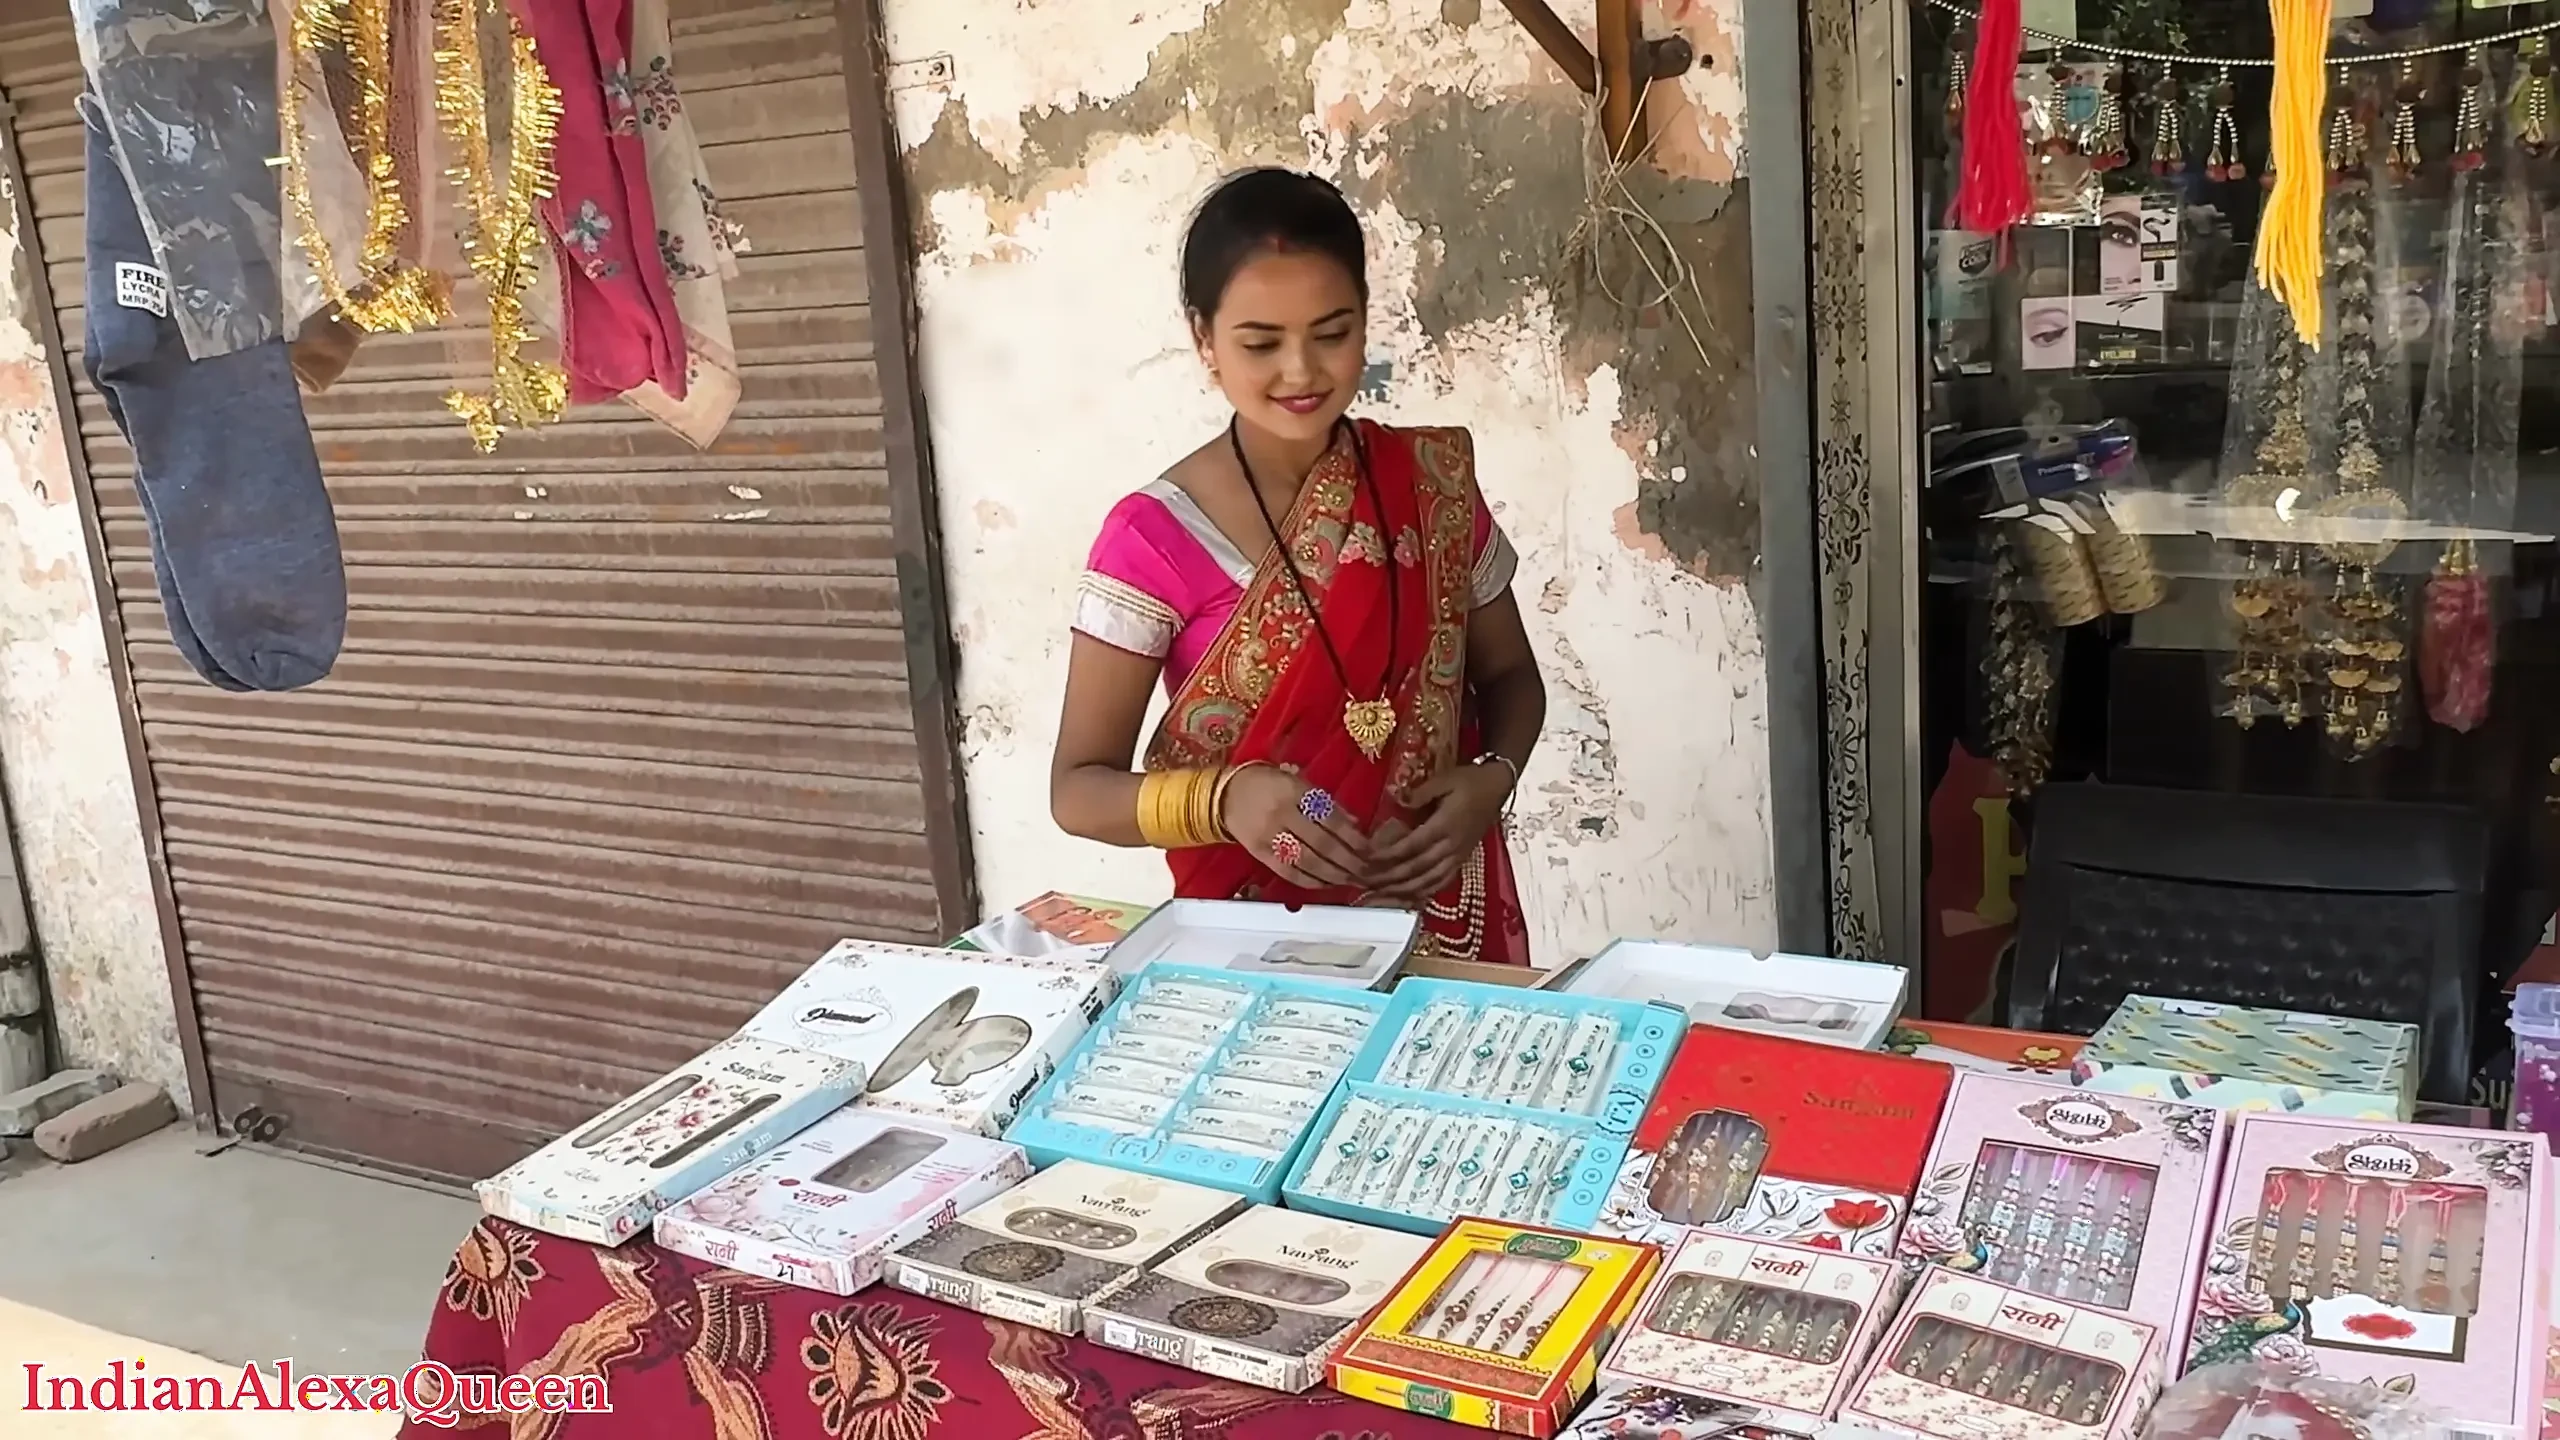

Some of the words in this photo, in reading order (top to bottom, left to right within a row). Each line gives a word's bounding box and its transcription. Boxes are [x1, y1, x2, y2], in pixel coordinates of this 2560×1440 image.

[121, 268, 166, 290] FIRE
[122, 281, 161, 300] LYCRA
[122, 294, 149, 305] MRP
[722, 1061, 787, 1084] Sangam
[721, 1132, 773, 1168] Sangam
[704, 1239, 740, 1262] रानी
[1275, 1235, 1359, 1269] Navrang
[1751, 1257, 1810, 1277] रानी
[2001, 1305, 2066, 1331] रानी
